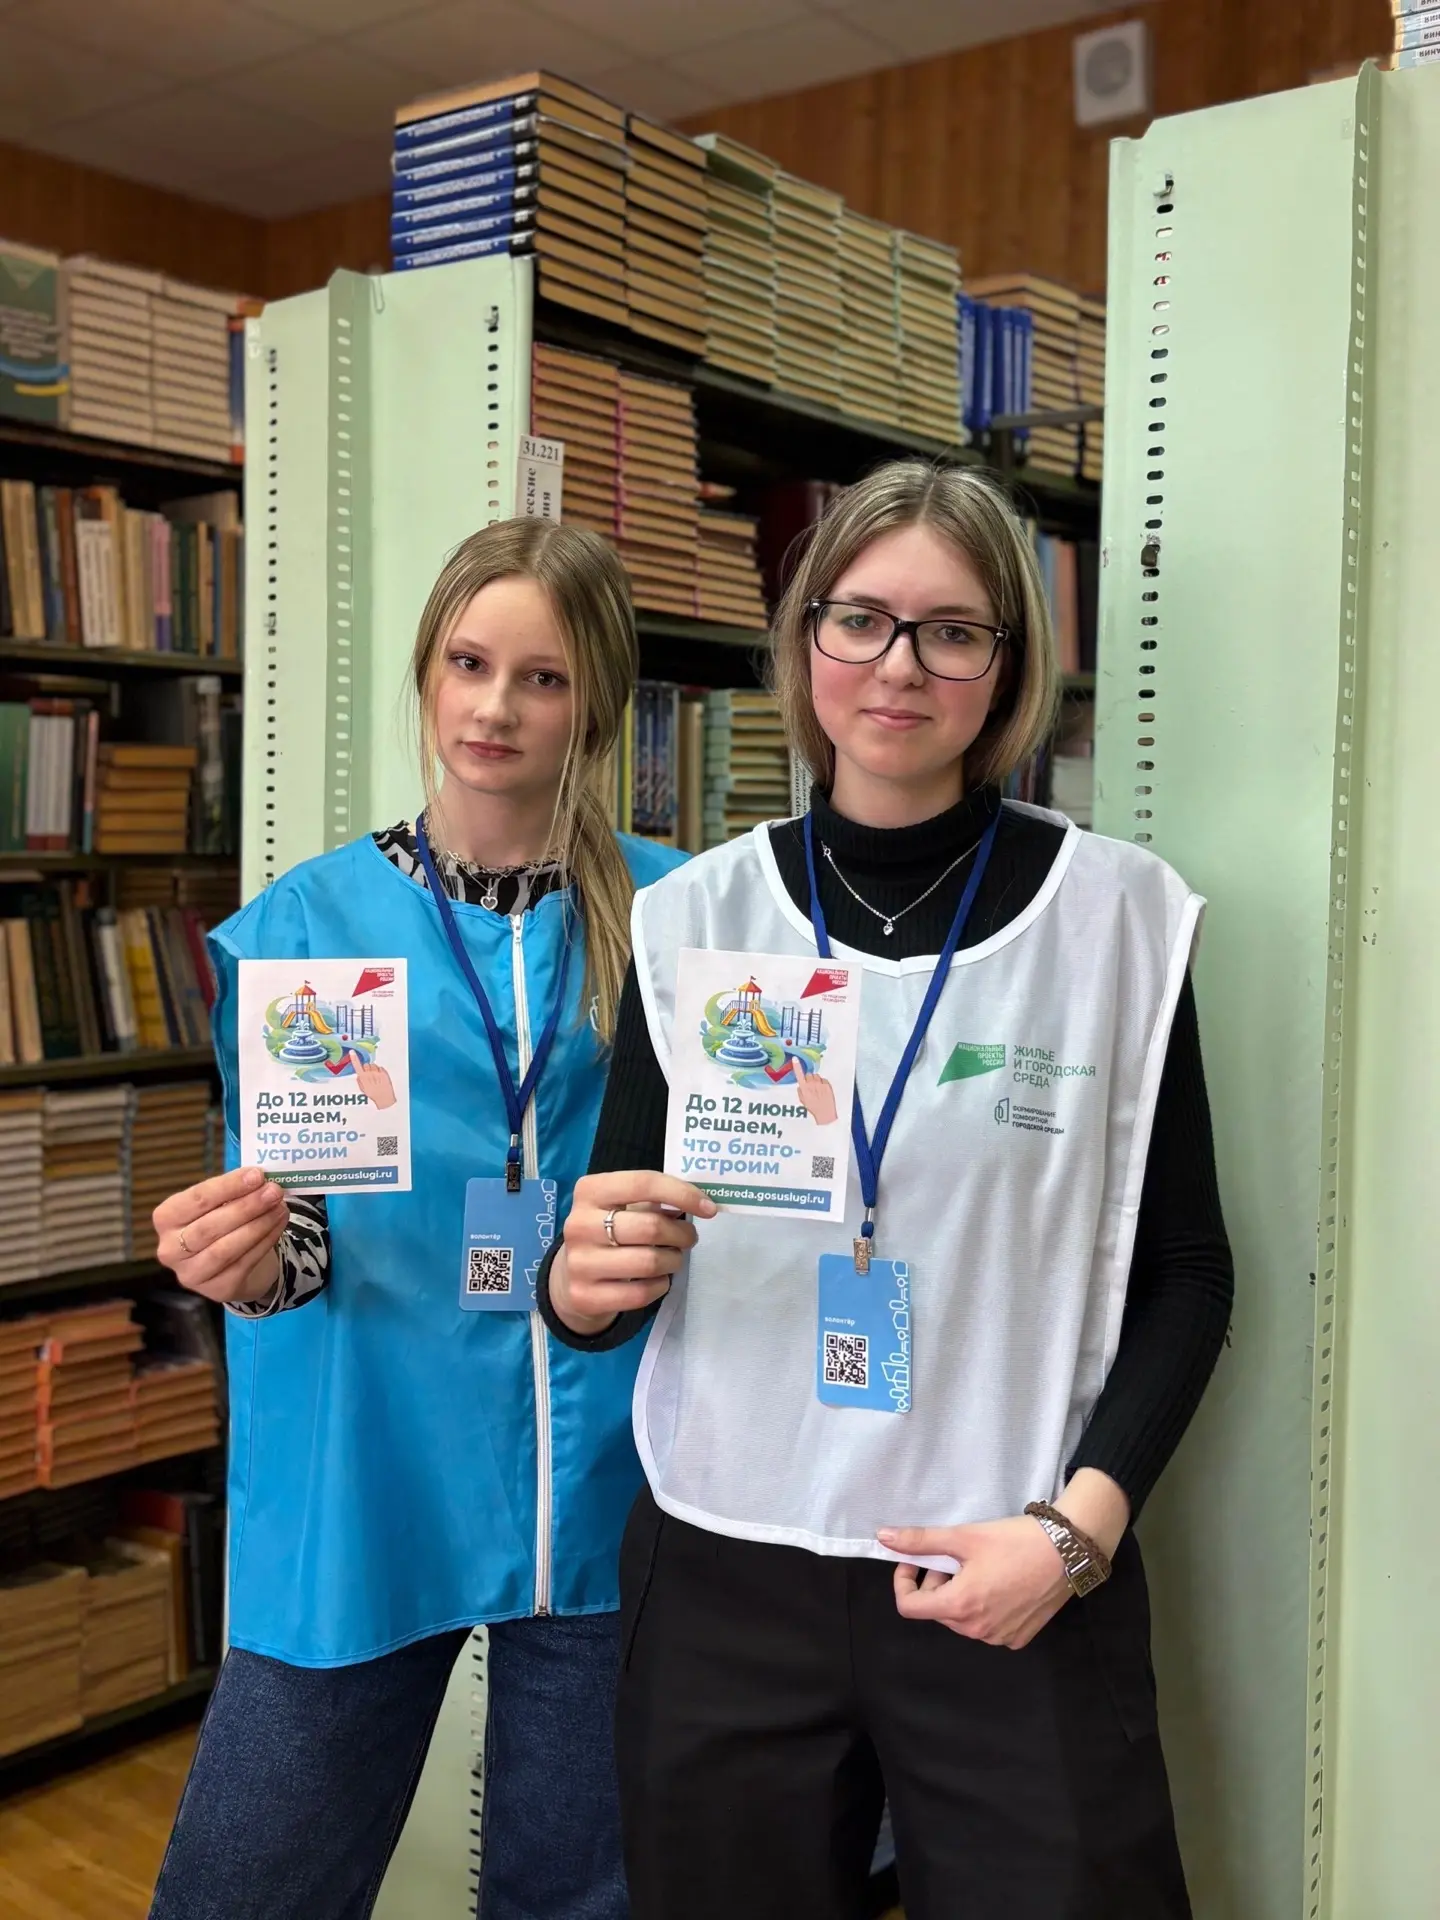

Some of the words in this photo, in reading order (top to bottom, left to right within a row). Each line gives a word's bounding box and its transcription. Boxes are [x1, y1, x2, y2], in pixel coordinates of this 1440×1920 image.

[523, 441, 559, 460] 31.221
[526, 467, 537, 515] еские
[1014, 1045, 1055, 1062] ЖИЛЬЕ
[1013, 1058, 1022, 1070] И
[1025, 1060, 1096, 1078] ГОРОДСКАЯ
[1013, 1072, 1050, 1088] СРЕДА
[256, 1092, 284, 1109] До
[288, 1092, 307, 1107] 12
[313, 1094, 368, 1107] июня
[685, 1093, 717, 1114] До
[722, 1096, 742, 1114] 12
[748, 1102, 808, 1118] июня
[257, 1110, 347, 1127] решаем,
[1012, 1105, 1057, 1118] ФОРМИРОВАНИЕ
[1012, 1113, 1049, 1124] КОМФОРТНОЙ
[685, 1115, 783, 1139] решаем,
[1012, 1121, 1043, 1132] ГОРОДСКОЙ
[1044, 1126, 1064, 1135] СРЕДЫ
[257, 1132, 291, 1144] что
[297, 1128, 366, 1144] благо-
[256, 1146, 347, 1164] устроим
[683, 1138, 721, 1153] что
[728, 1138, 801, 1158] благо-
[681, 1156, 779, 1176] устроим
